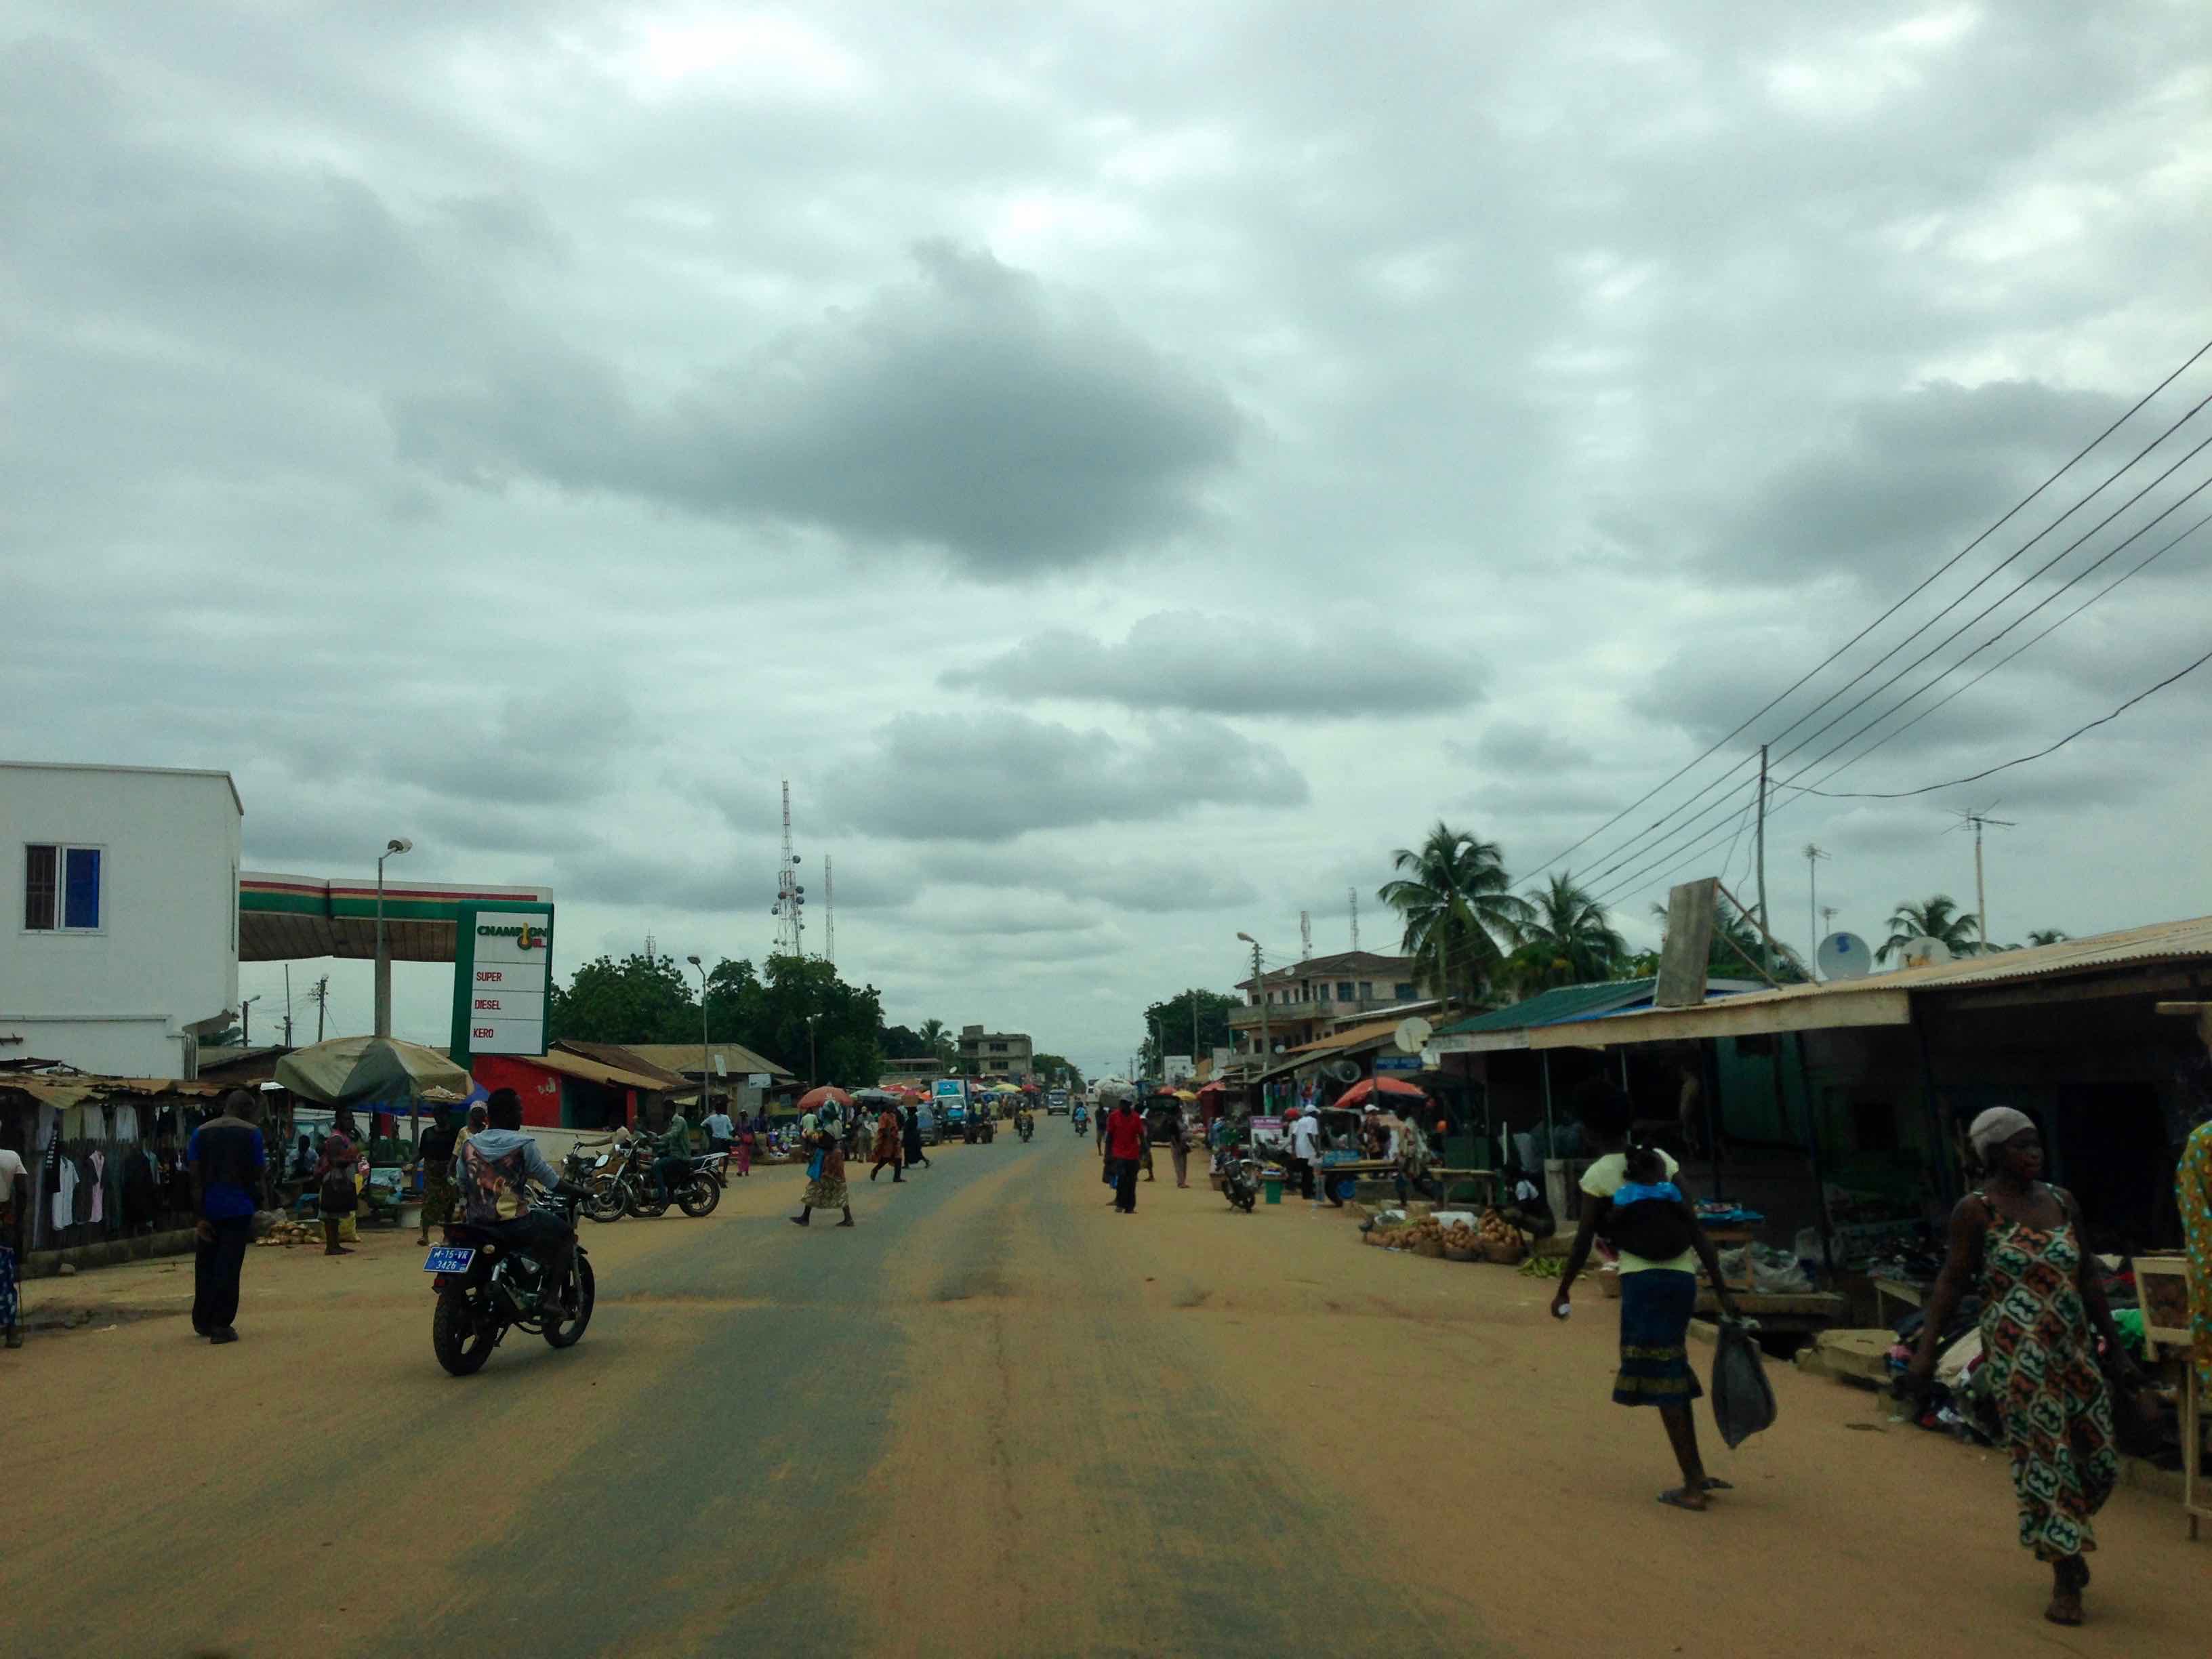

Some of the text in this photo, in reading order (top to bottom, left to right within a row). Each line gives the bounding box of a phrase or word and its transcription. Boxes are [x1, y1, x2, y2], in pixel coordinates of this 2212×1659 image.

[476, 971, 501, 982] SUPER
[474, 1000, 501, 1010] DIESEL
[473, 1028, 493, 1038] KERO
[436, 1260, 457, 1270] 3426
